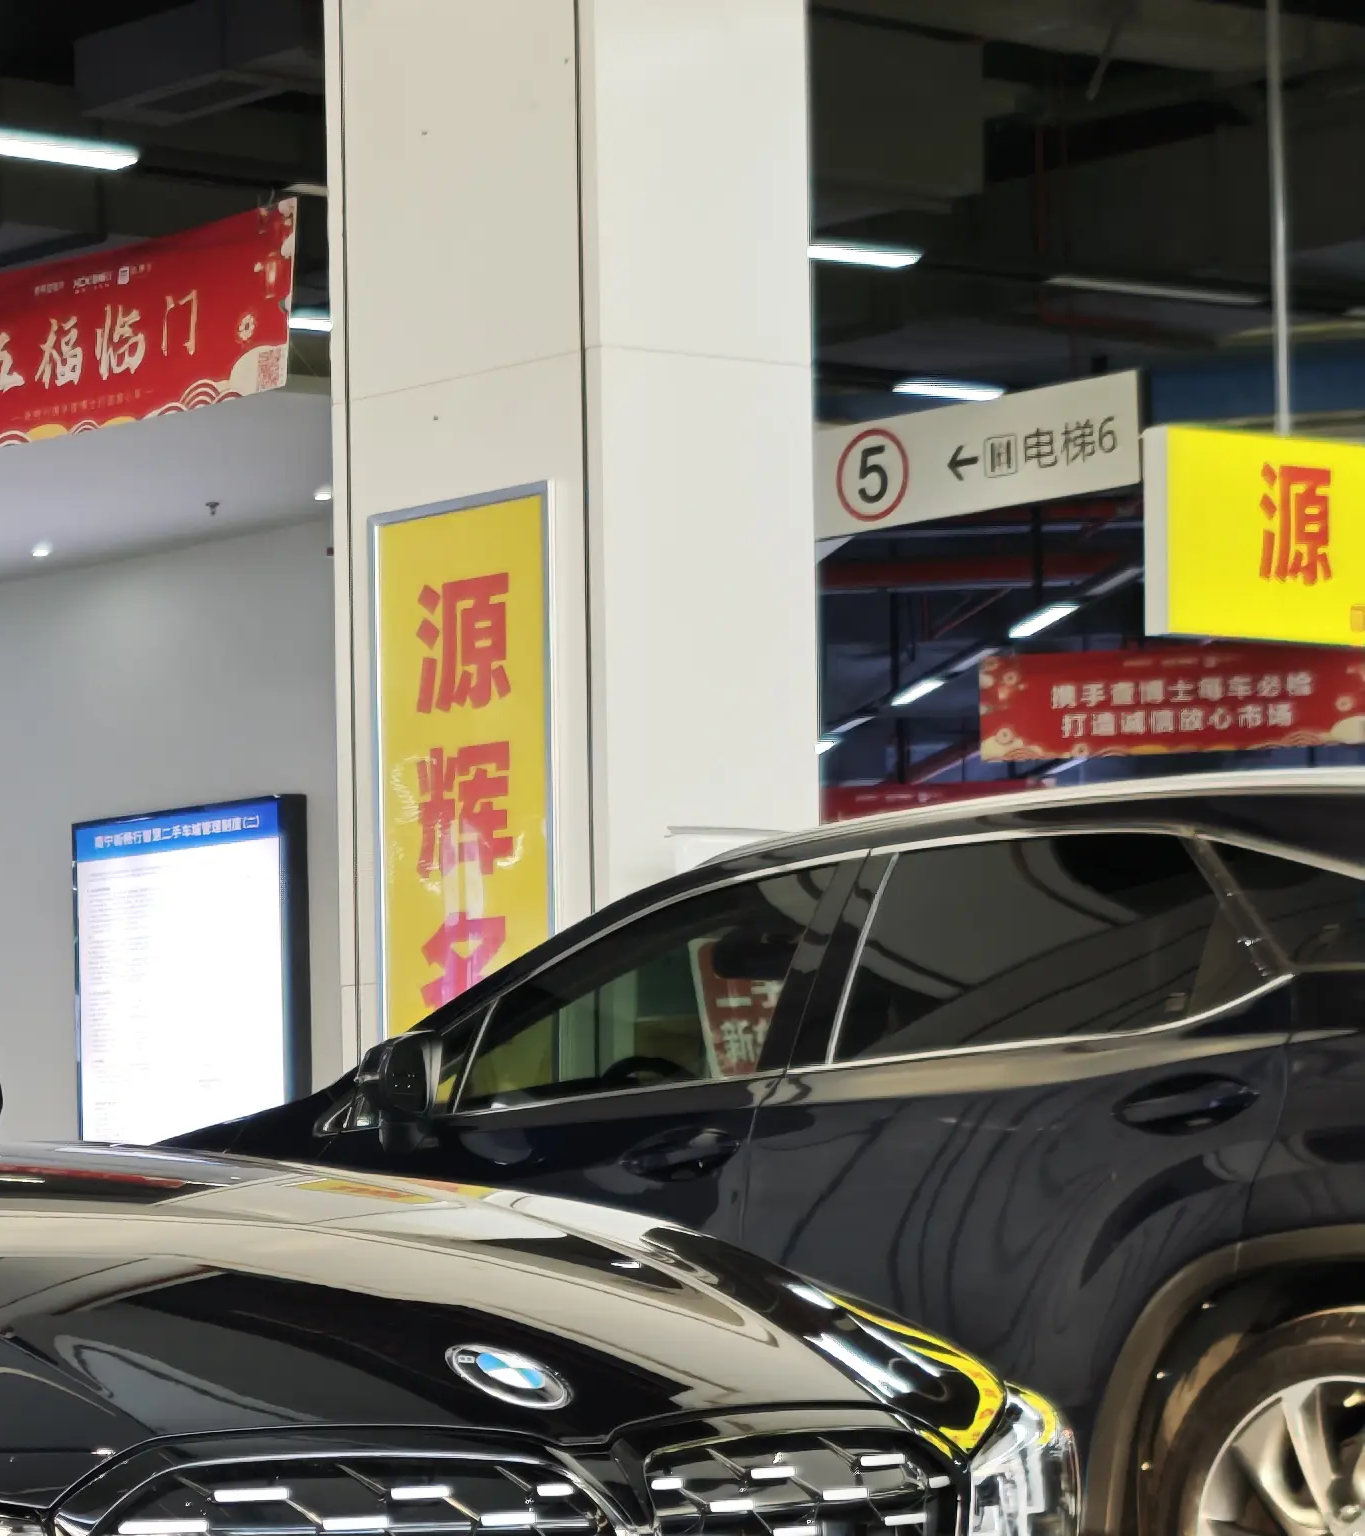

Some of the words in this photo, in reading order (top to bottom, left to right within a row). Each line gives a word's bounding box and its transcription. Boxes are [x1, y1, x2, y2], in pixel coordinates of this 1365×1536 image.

[1024, 416, 1118, 469] 电梯6
[857, 445, 888, 503] 5
[1259, 462, 1332, 586] 源
